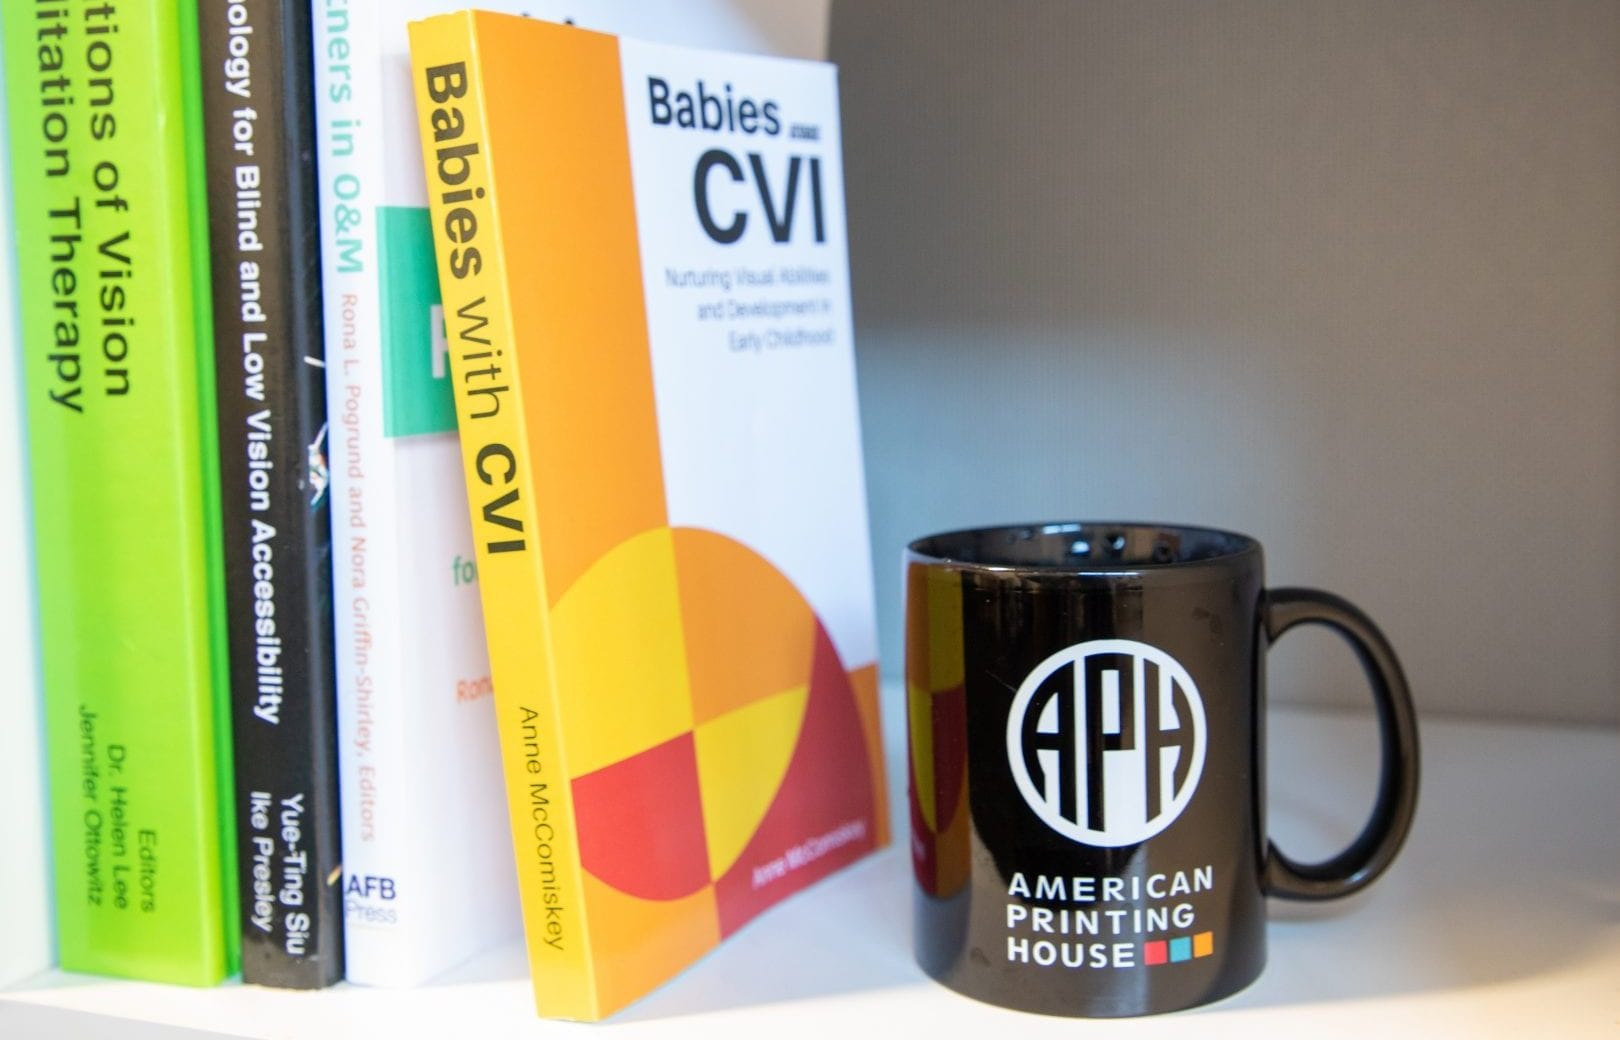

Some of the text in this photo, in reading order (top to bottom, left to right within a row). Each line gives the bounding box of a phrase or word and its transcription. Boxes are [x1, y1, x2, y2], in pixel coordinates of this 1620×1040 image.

[331, 119, 361, 157] in
[648, 75, 781, 136] Babies
[94, 160, 130, 214] of
[332, 173, 364, 274] O&M
[693, 148, 825, 245] CVI
[47, 197, 84, 414] Therapy
[97, 230, 135, 396] Vision
[341, 293, 359, 350] Rona
[424, 60, 526, 555] Babies with CVI
[224, 0, 283, 725] ology for Blind and Low Vision Accessibility
[344, 358, 360, 376] L.
[342, 384, 365, 479] Pogrund
[348, 486, 367, 530] and
[350, 536, 367, 590] Nora
[79, 703, 98, 801] Jennifer
[107, 744, 131, 910] Dr. Helen Lee
[358, 764, 376, 843] Editors
[519, 706, 564, 951] Anne McComiskey
[138, 828, 157, 913] Editors
[250, 791, 276, 933] Ike Presley
[278, 792, 310, 956] Yue-Ting Siu
[345, 874, 398, 925] AFB Press
[1008, 866, 1214, 903] AMERICAN
[1006, 904, 1196, 935] PRINTING
[1006, 937, 1136, 968] HOUSE
